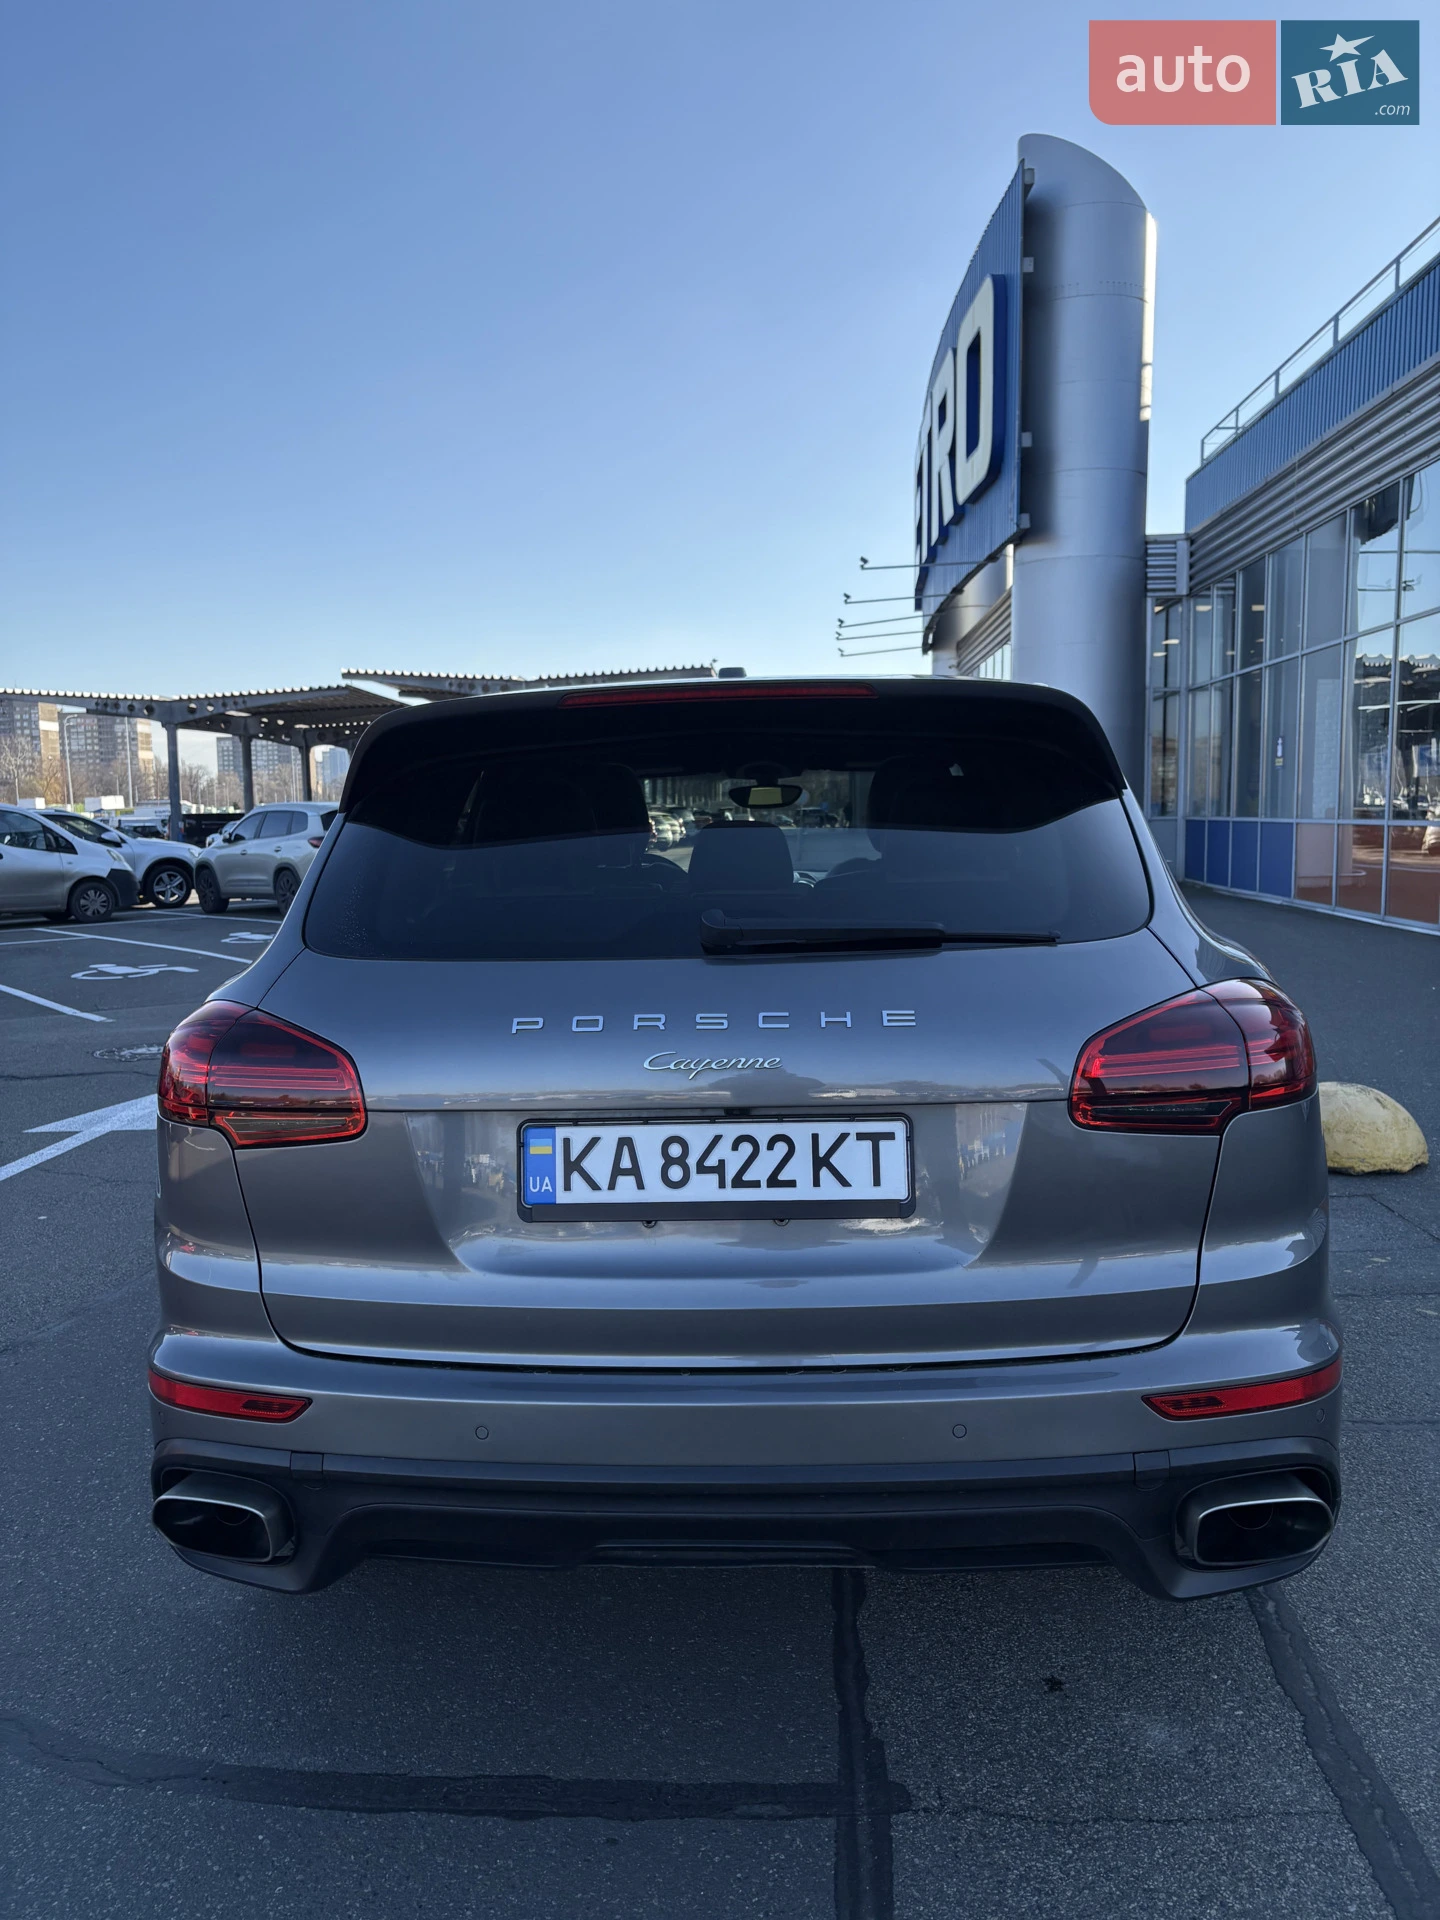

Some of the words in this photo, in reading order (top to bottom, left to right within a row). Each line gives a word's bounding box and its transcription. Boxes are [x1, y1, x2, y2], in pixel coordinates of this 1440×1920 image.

[511, 1009, 917, 1034] PORSCHE
[643, 1051, 783, 1080] Cayenne
[562, 1136, 646, 1192] KA
[660, 1133, 798, 1190] 8422
[810, 1131, 897, 1188] KT
[529, 1176, 553, 1193] UA
